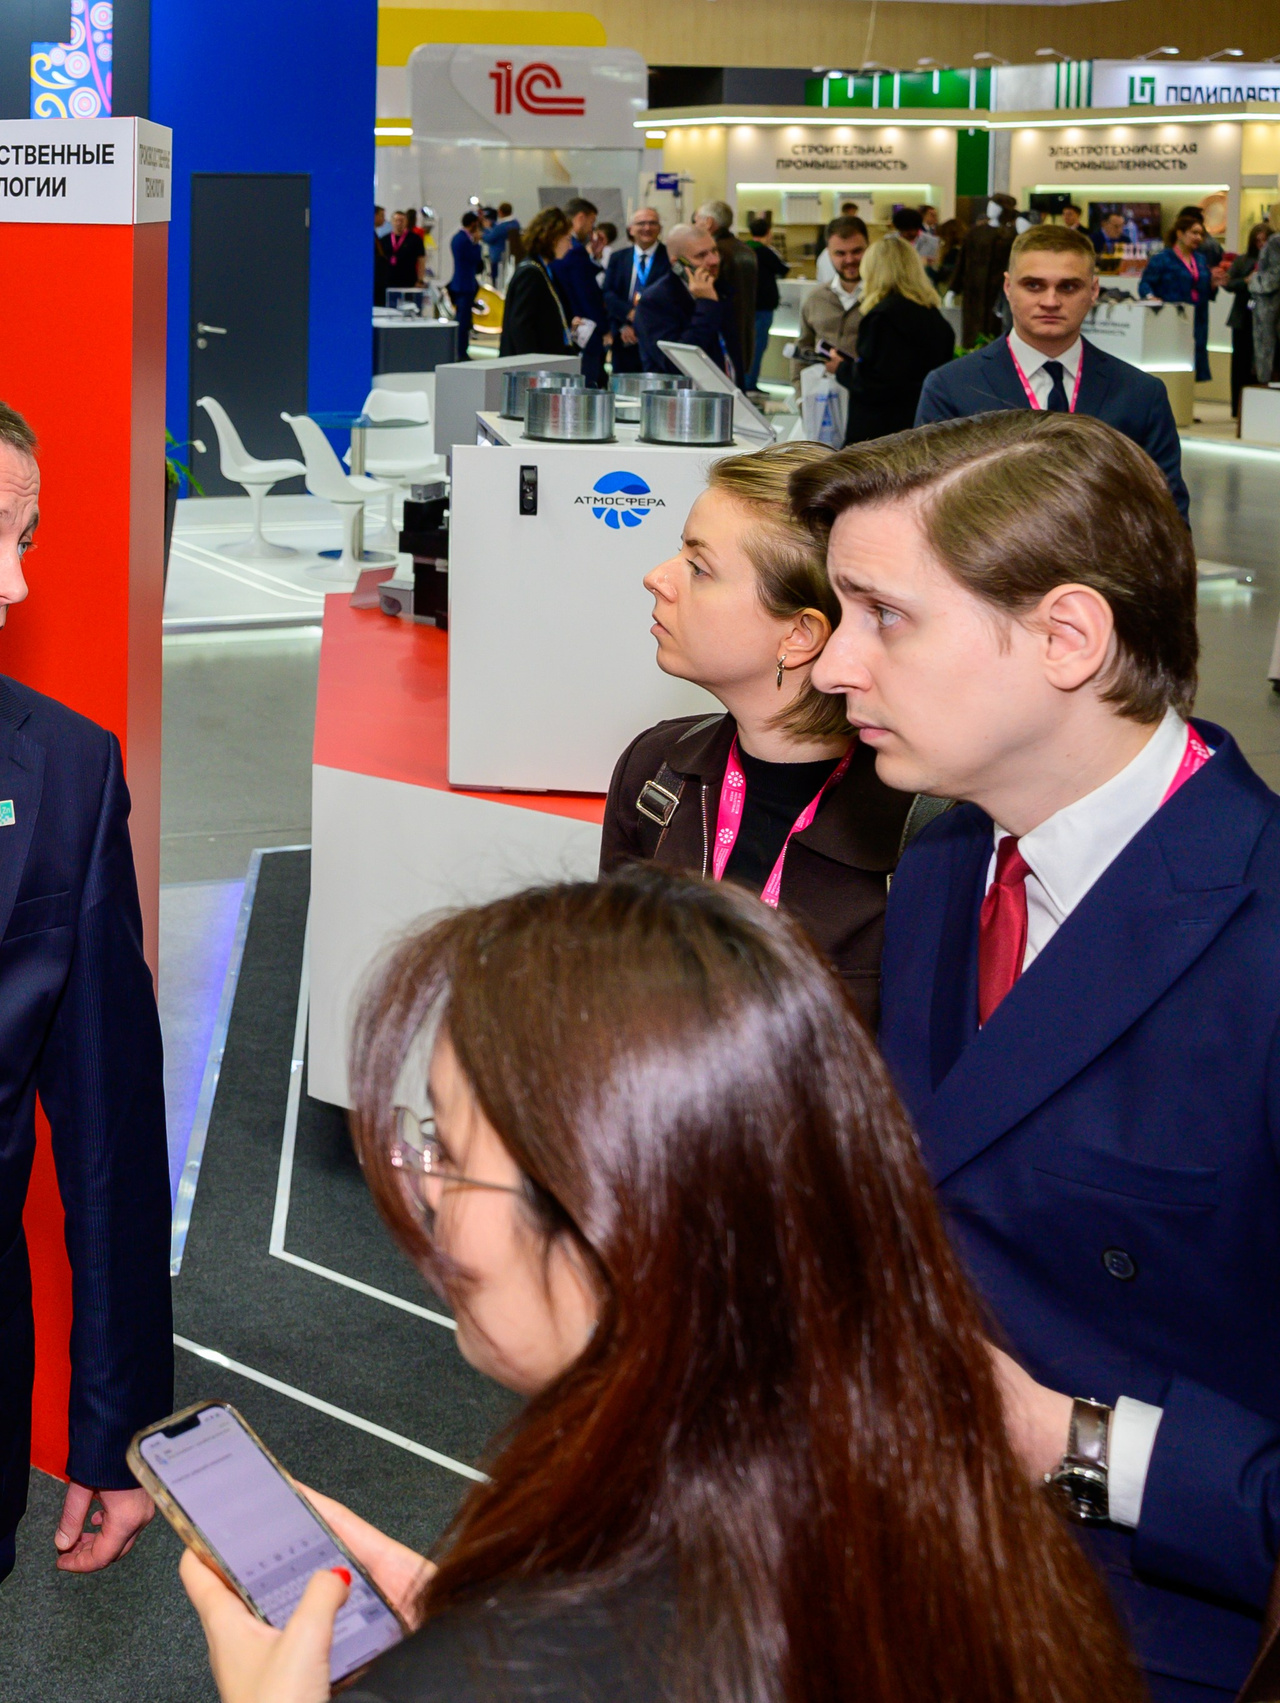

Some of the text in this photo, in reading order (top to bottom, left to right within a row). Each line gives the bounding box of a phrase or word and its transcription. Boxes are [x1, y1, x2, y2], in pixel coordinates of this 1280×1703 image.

[791, 144, 893, 156] СТРОИТЕЛЬНАЯ
[1049, 143, 1198, 157] ЭЛЕКТРОТЕХНИЧЕСКАЯ
[776, 158, 908, 171] ПРОМЫШЛЕННОСТЬ
[1055, 158, 1188, 172] ПРОМЫШЛЕННОСТЬ
[574, 496, 666, 507] АТМОСФЕРА
